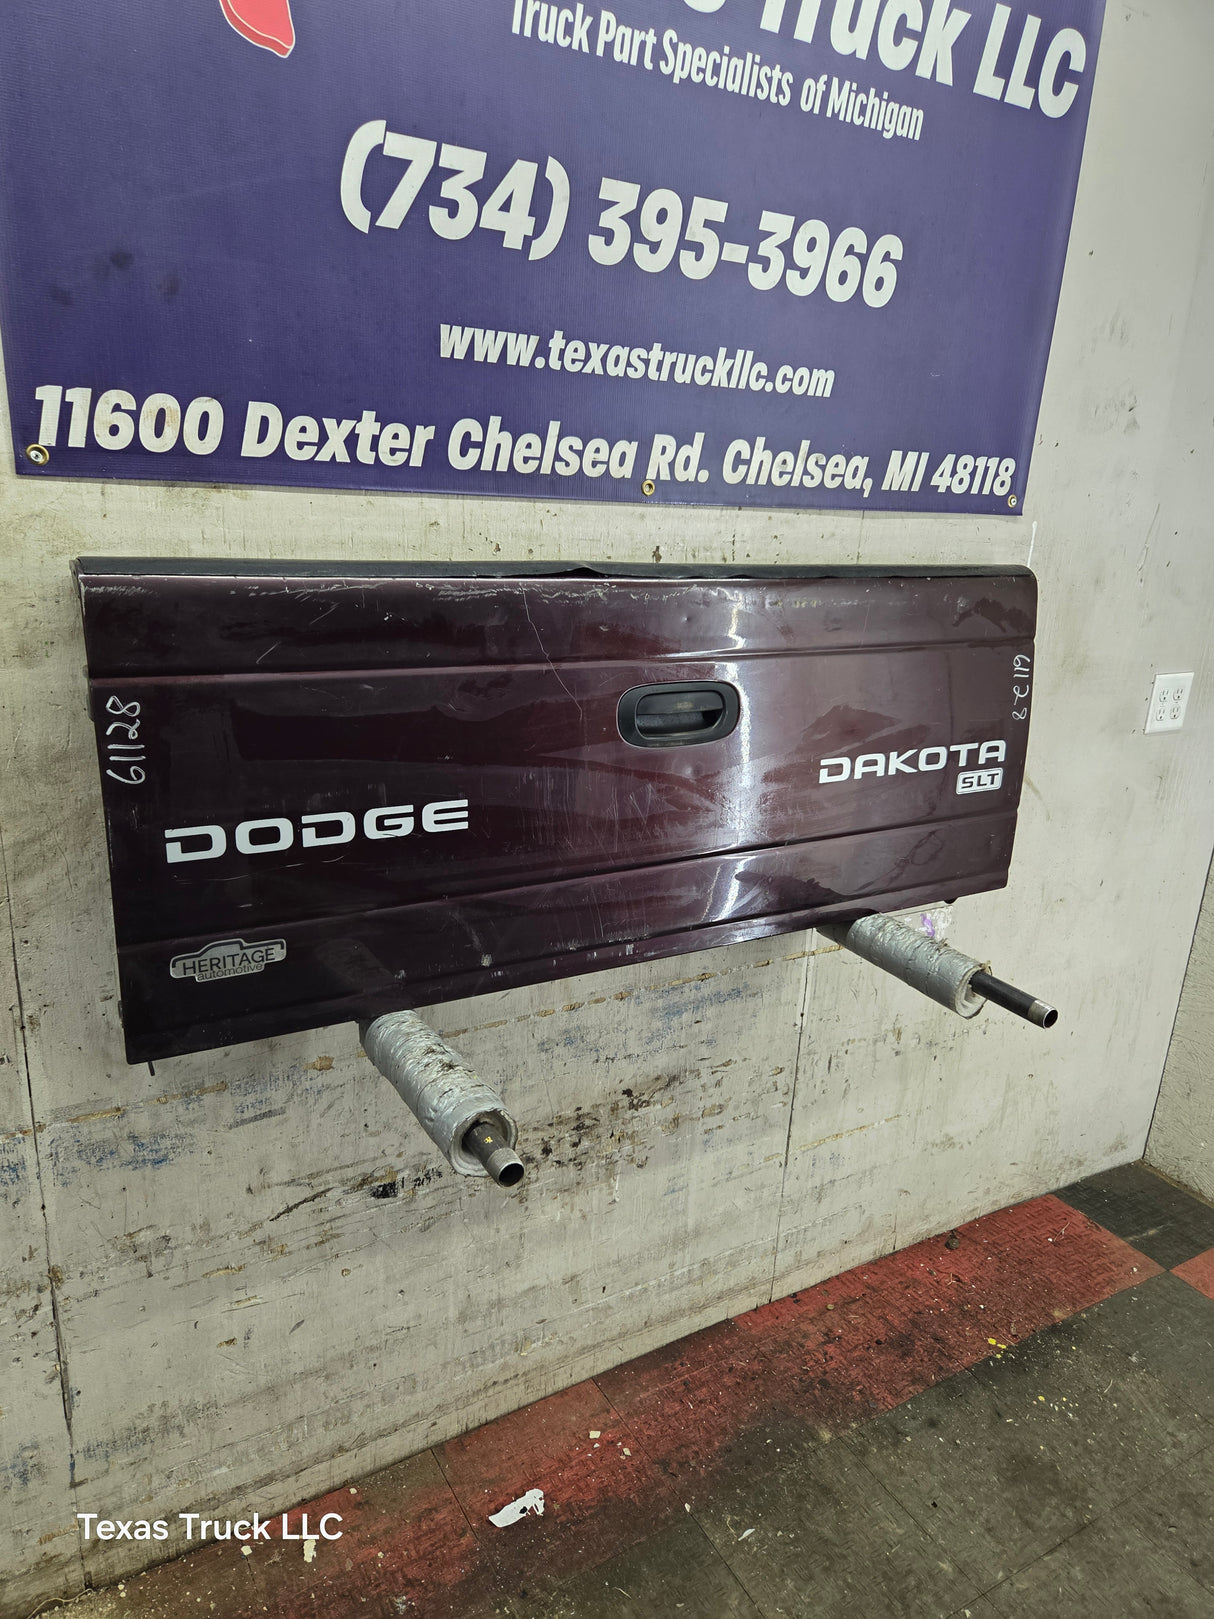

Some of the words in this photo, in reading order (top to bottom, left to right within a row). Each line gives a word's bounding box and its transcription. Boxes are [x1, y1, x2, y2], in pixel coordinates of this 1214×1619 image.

[512, 0, 593, 53] Truck
[596, 10, 657, 70] Part
[660, 29, 793, 106] Specialists
[800, 74, 829, 114] of
[826, 76, 925, 140] Michigan
[973, 3, 1086, 118] LLC
[341, 120, 569, 260] (734)
[588, 177, 903, 308] 395-3966
[440, 324, 835, 397] www.texastruckllc.com
[35, 385, 223, 455] 11600
[241, 401, 435, 466] Dexter
[448, 416, 638, 478] Chelsea
[646, 432, 709, 482] Rd.
[722, 437, 872, 497] Chelsea,
[881, 450, 929, 491] MI
[930, 453, 1016, 495] 48118
[105, 695, 146, 785] 61128
[819, 740, 1006, 783] DAKOTA
[961, 773, 999, 789] SLT
[165, 800, 468, 863] DODGE
[183, 947, 275, 975] HERITAGE
[197, 962, 263, 981] automotive
